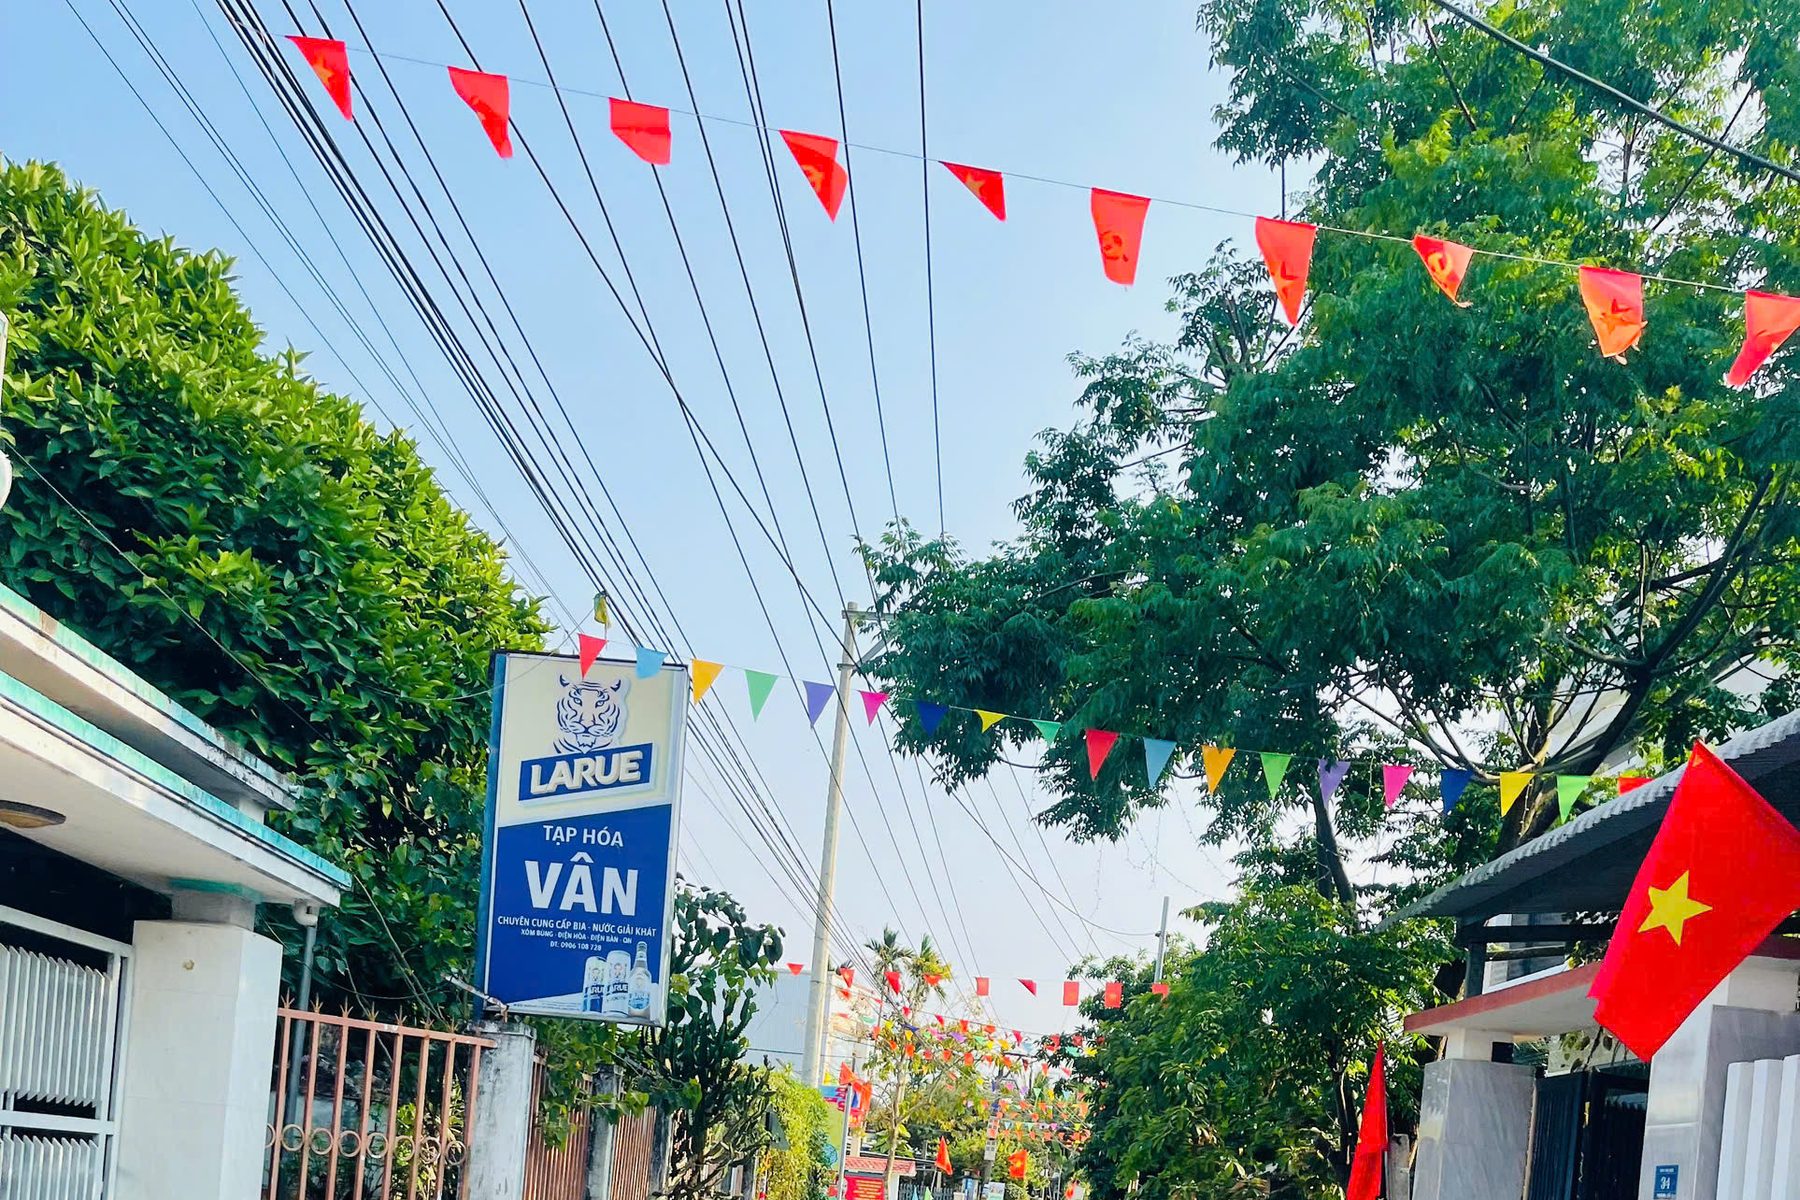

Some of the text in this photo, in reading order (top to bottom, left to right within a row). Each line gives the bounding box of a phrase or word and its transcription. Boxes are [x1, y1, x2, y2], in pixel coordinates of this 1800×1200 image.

[530, 750, 643, 795] LARUE
[543, 825, 624, 847] TẠP HÓA
[524, 852, 639, 917] VÂN
[497, 916, 529, 927] CHUYÊN
[531, 918, 554, 928] CUNG
[556, 918, 572, 930] CẤP
[573, 922, 587, 931] BIA
[592, 923, 616, 933] NƯỚC
[617, 924, 634, 935] GIẢI
[635, 927, 657, 937] KHÁT
